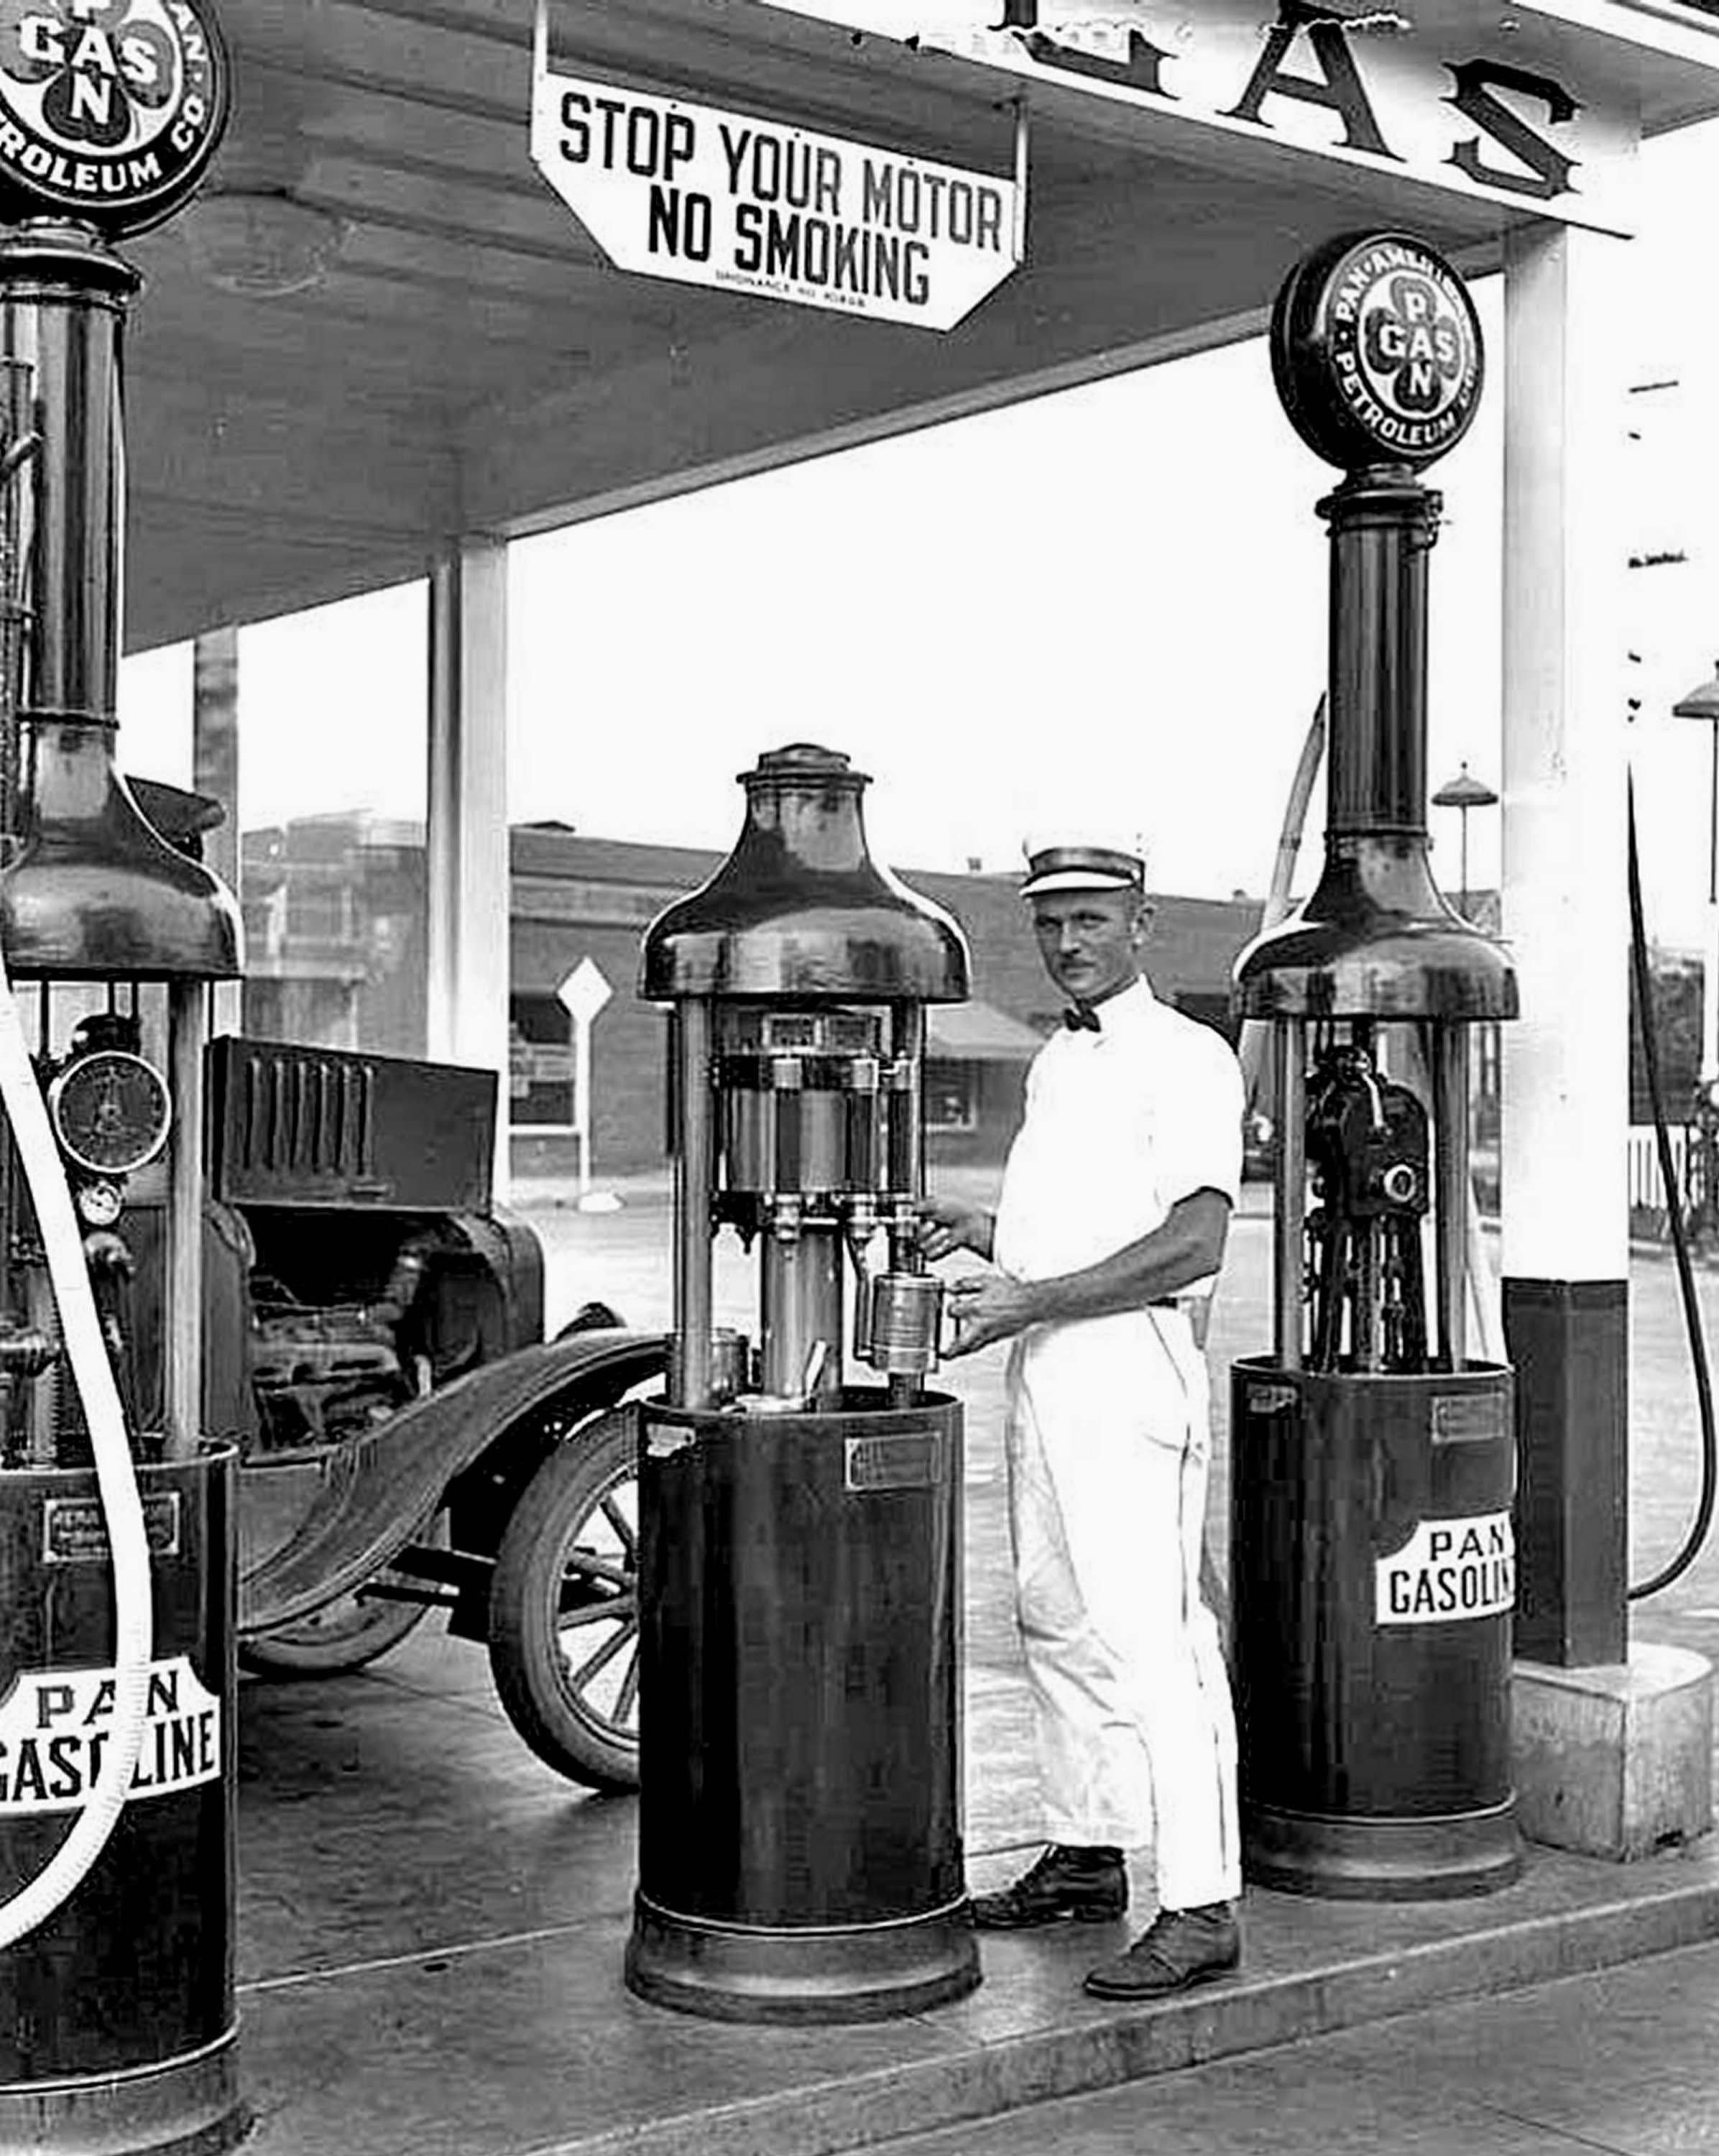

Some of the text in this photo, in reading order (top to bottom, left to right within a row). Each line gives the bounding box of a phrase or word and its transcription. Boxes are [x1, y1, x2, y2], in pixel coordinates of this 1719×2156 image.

[20, 14, 157, 84] GAS
[559, 91, 1003, 252] STOP YOUR MOTOR
[648, 185, 930, 306] NO SMOKING
[1378, 323, 1454, 363] GAS
[1335, 350, 1456, 445] PETROLEUM
[1429, 1521, 1505, 1561] PAN
